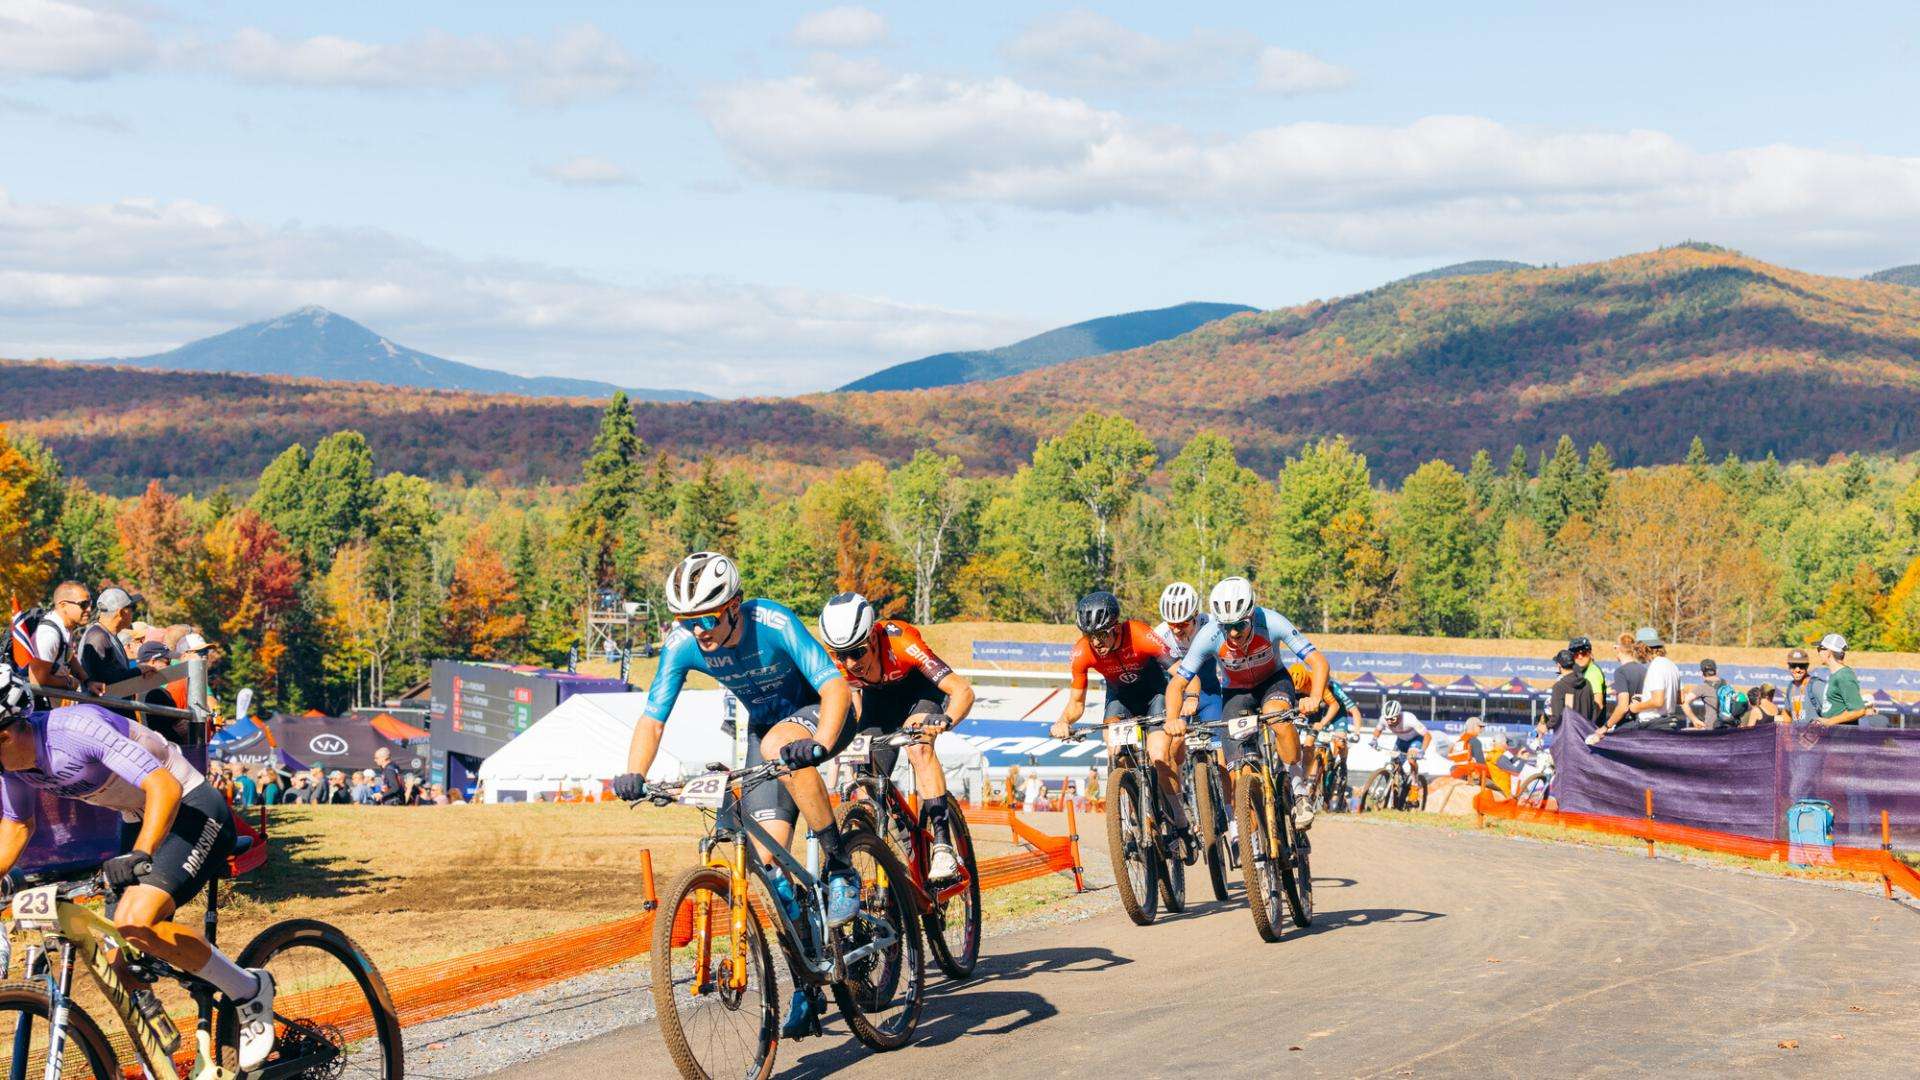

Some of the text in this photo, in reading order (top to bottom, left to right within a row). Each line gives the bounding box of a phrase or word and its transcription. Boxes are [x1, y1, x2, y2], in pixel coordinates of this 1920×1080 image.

[905, 644, 938, 669] BMC
[853, 738, 864, 751] 9
[687, 779, 719, 794] 28
[19, 891, 49, 915] 23
